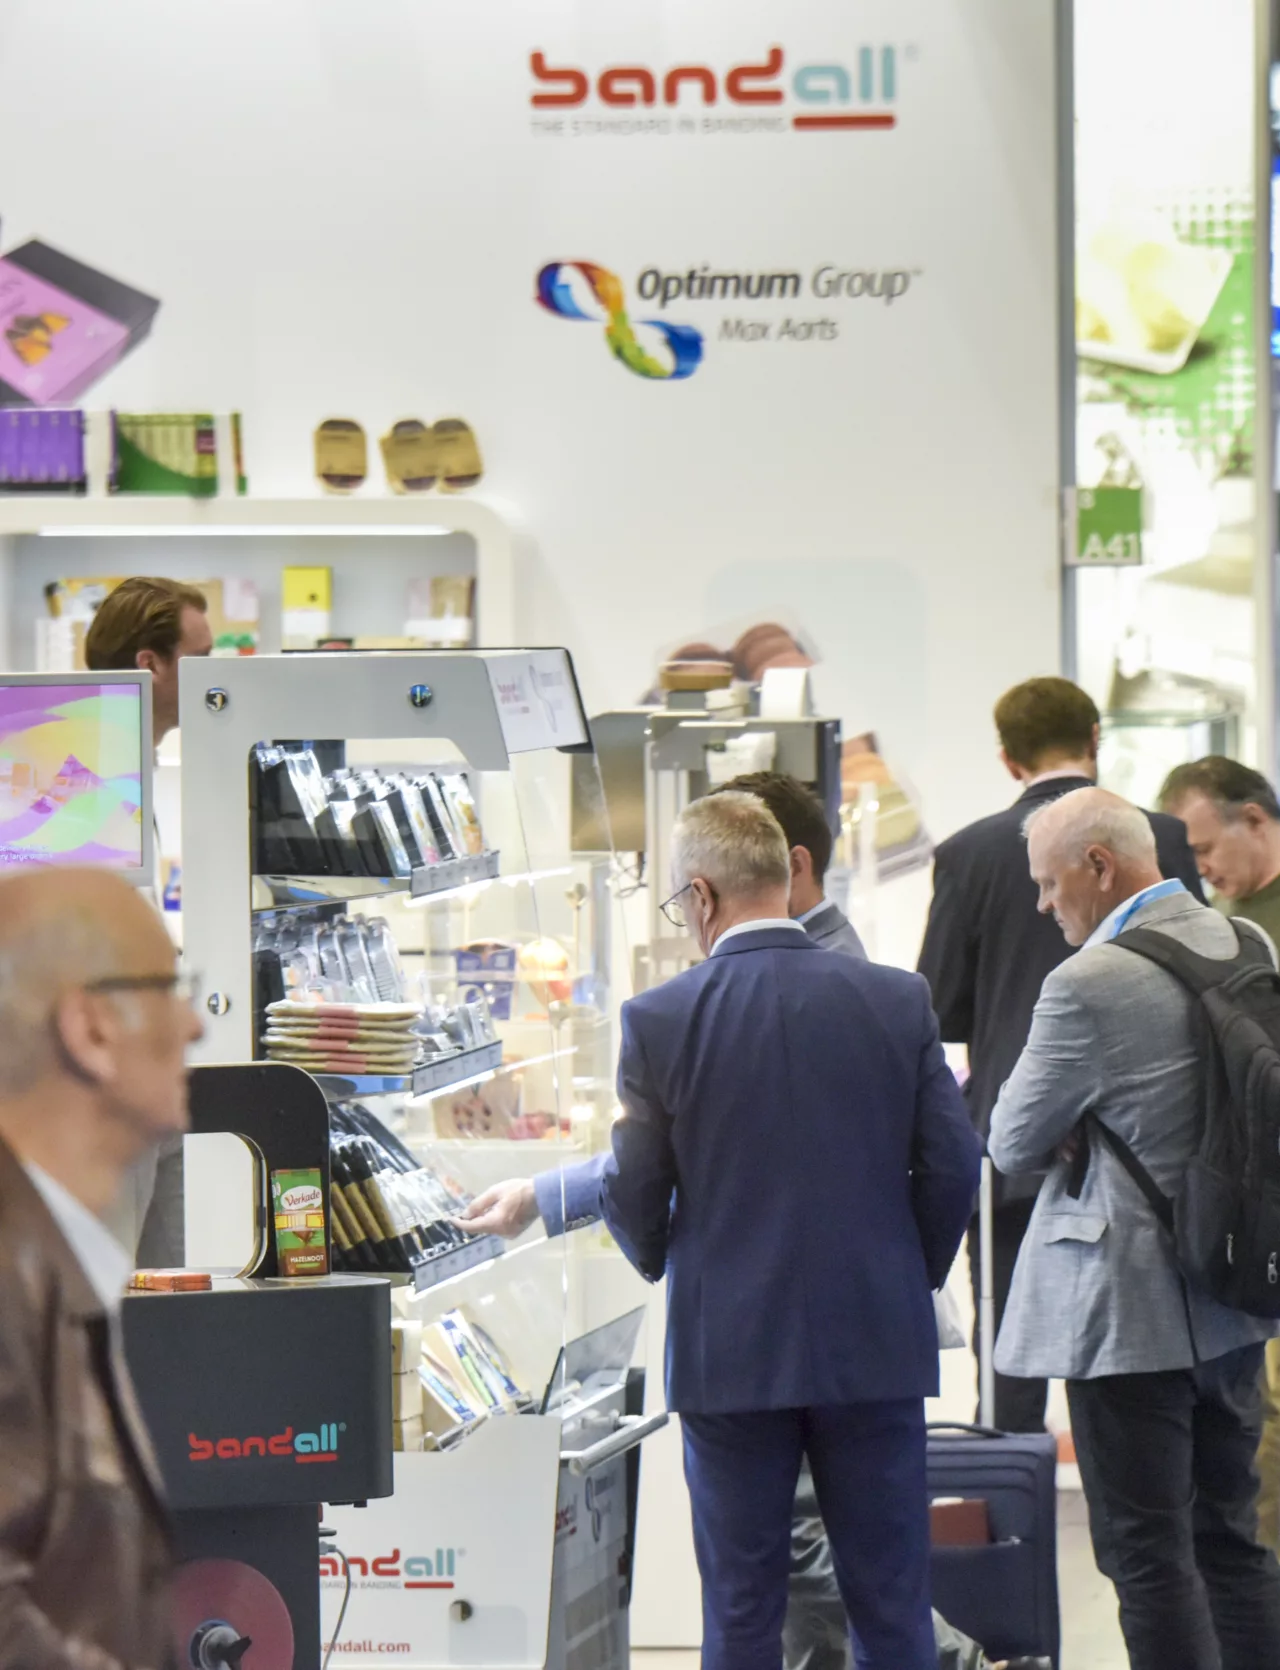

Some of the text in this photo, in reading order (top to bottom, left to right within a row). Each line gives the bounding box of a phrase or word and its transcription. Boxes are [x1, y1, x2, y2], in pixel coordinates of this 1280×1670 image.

[530, 46, 896, 107] bandall
[637, 262, 911, 309] Optimum Group
[717, 317, 839, 342] Max Aarts
[285, 1189, 320, 1207] Verkade
[290, 1254, 324, 1263] HAZELNOOT
[188, 1422, 338, 1461] bandall
[319, 1548, 455, 1577] andall
[320, 1640, 411, 1653] andall.com
